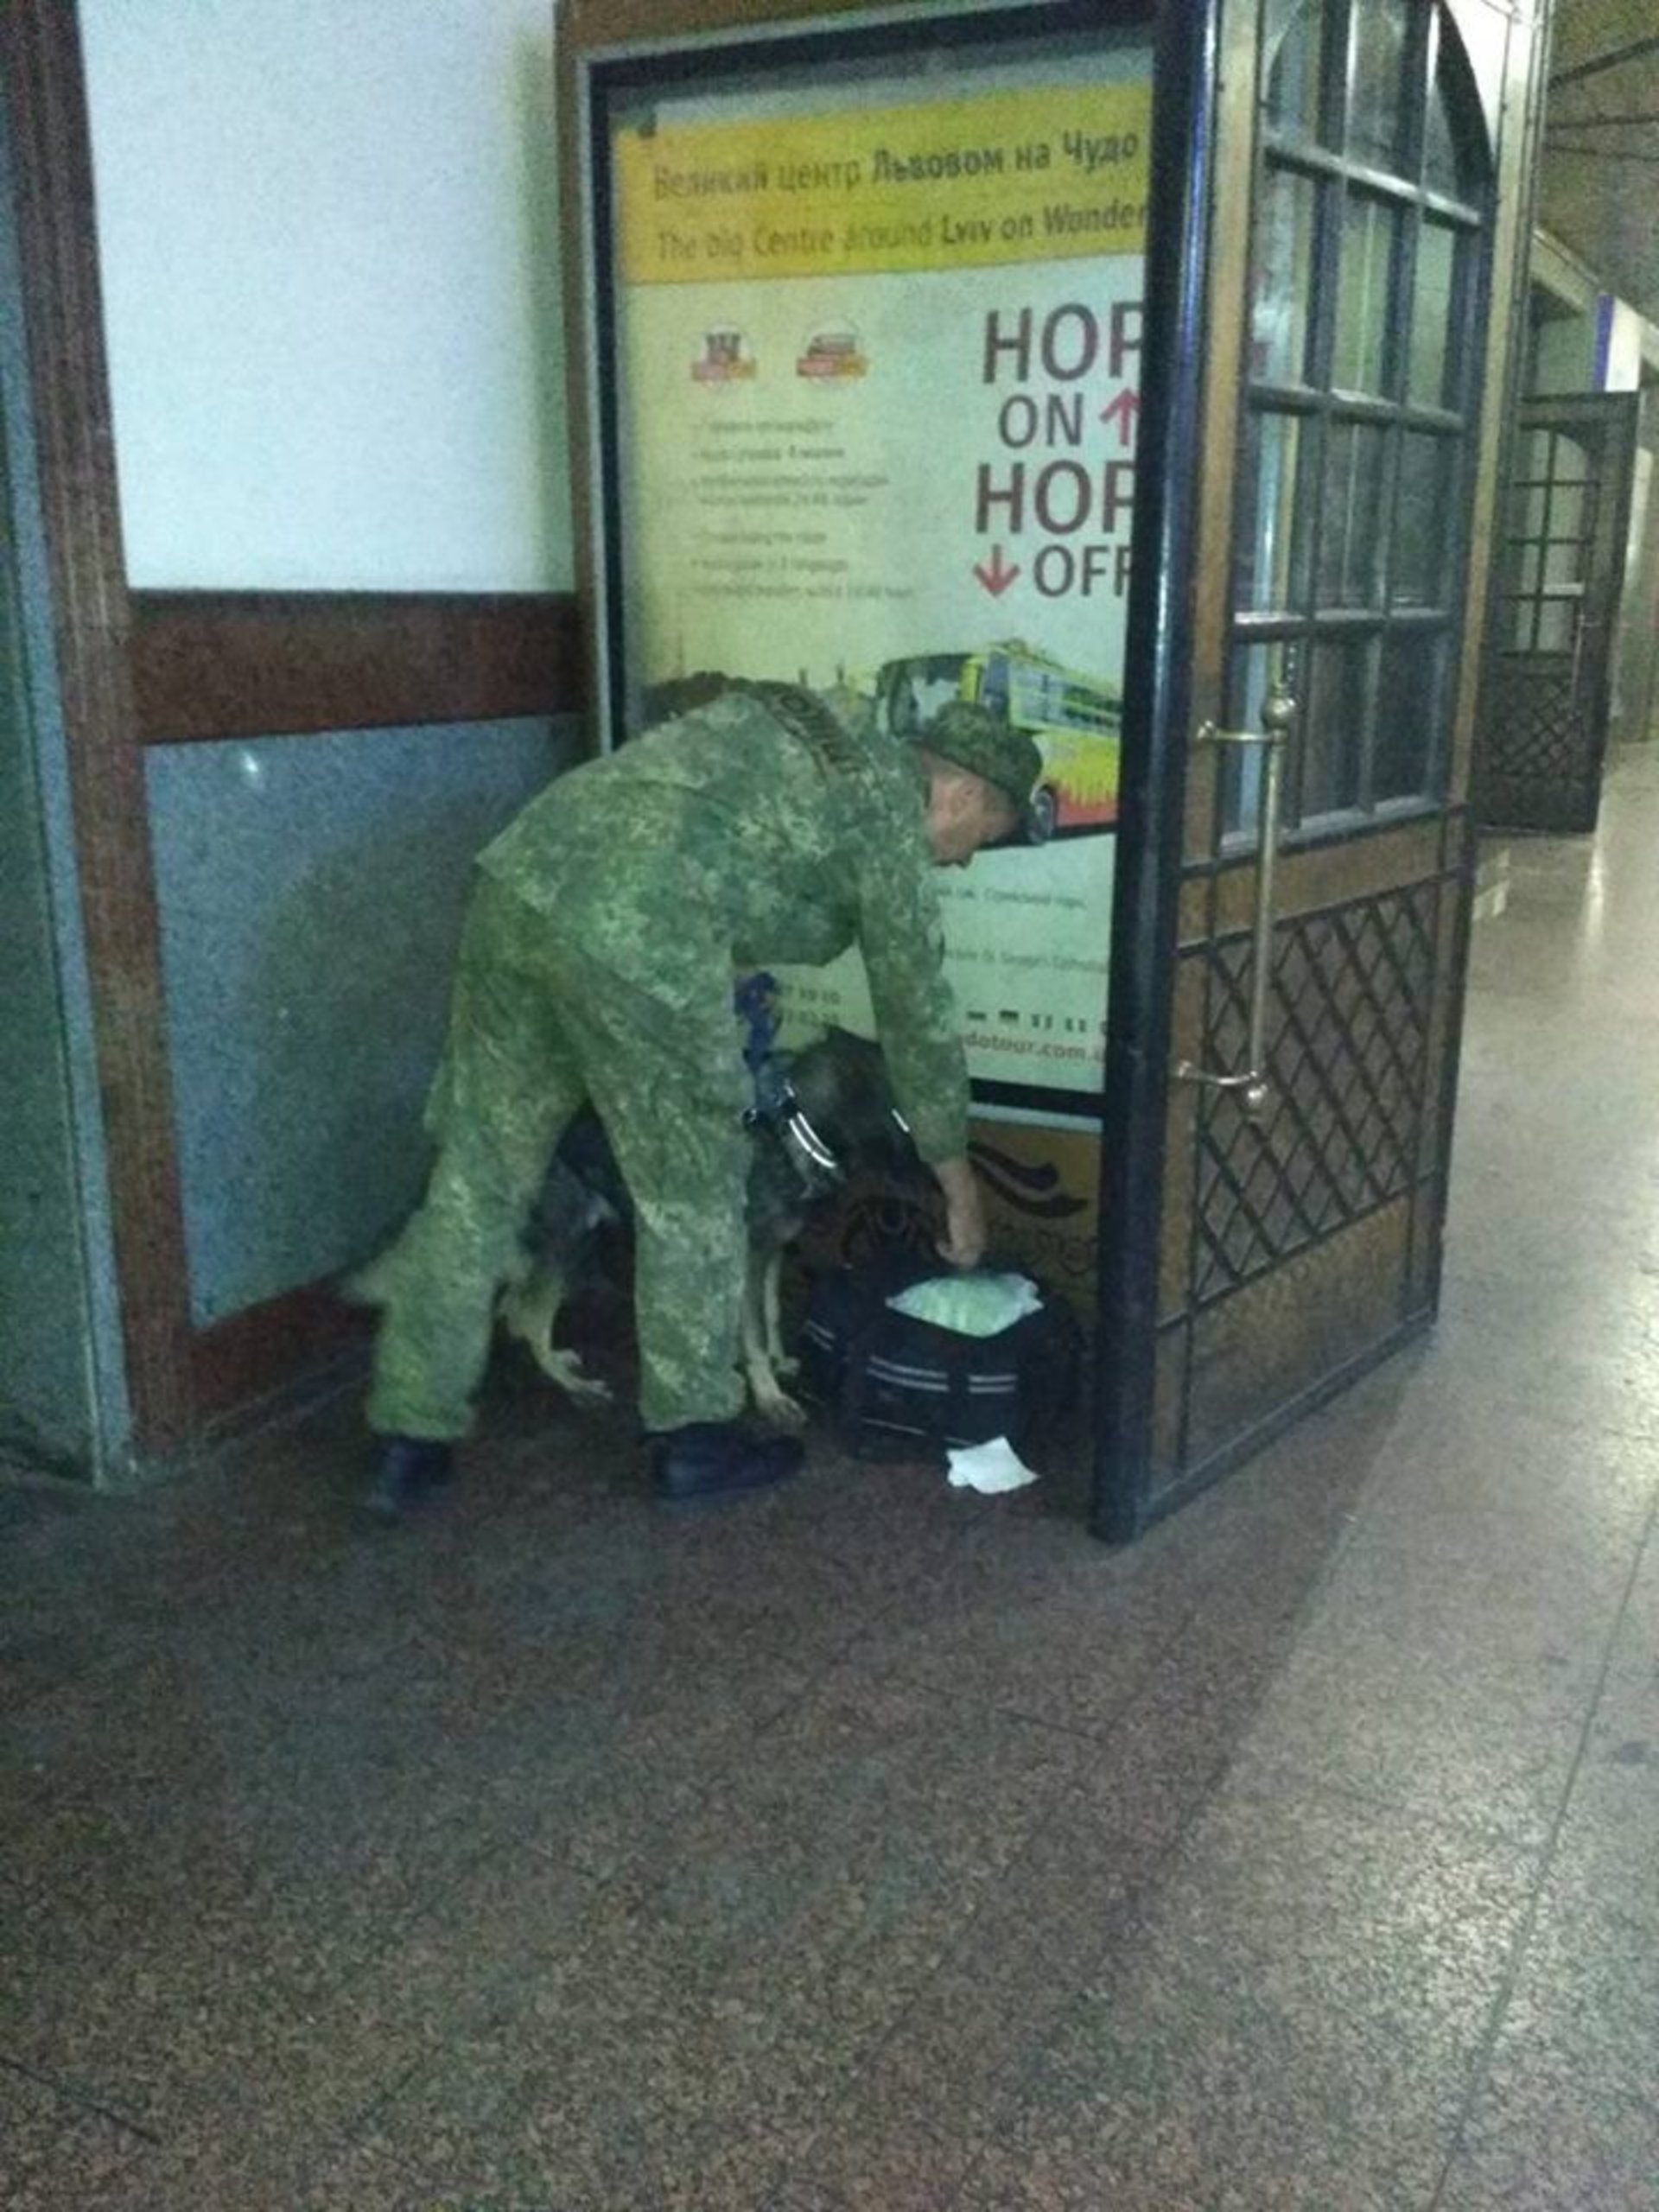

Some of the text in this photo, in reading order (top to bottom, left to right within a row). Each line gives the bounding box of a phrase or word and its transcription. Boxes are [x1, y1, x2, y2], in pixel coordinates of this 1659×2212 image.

[778, 160, 861, 194] центр
[873, 148, 1004, 183] Львовом
[1015, 143, 1051, 169] на
[1063, 130, 1138, 174] Чудо
[941, 214, 991, 245] Lviv
[1001, 215, 1033, 240] on
[999, 391, 1084, 448] ON
